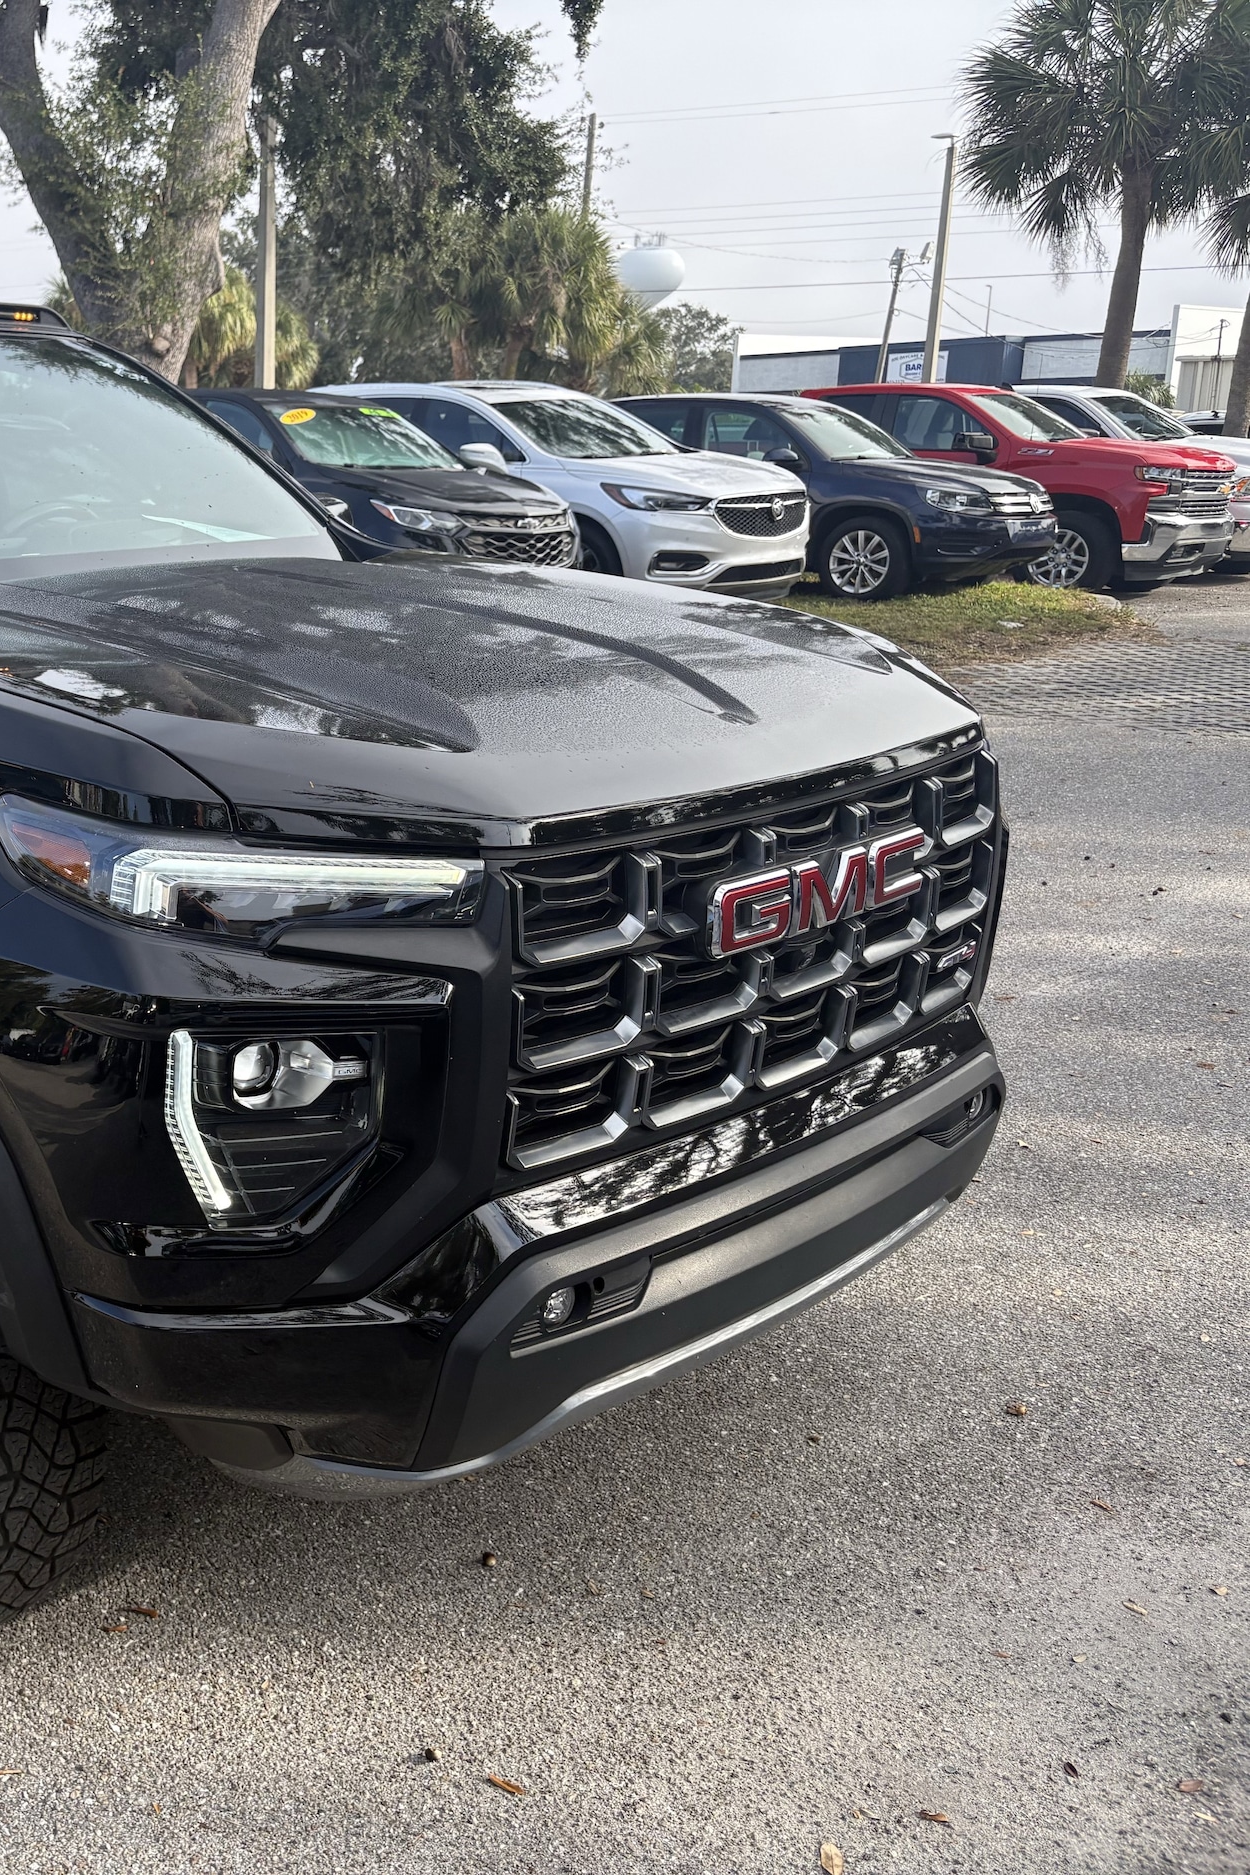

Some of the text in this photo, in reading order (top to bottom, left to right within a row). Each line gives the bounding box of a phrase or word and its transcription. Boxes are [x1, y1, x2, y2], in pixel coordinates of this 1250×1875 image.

[287, 410, 308, 423] 2019
[711, 827, 930, 957] GMC
[936, 941, 976, 972] AT4
